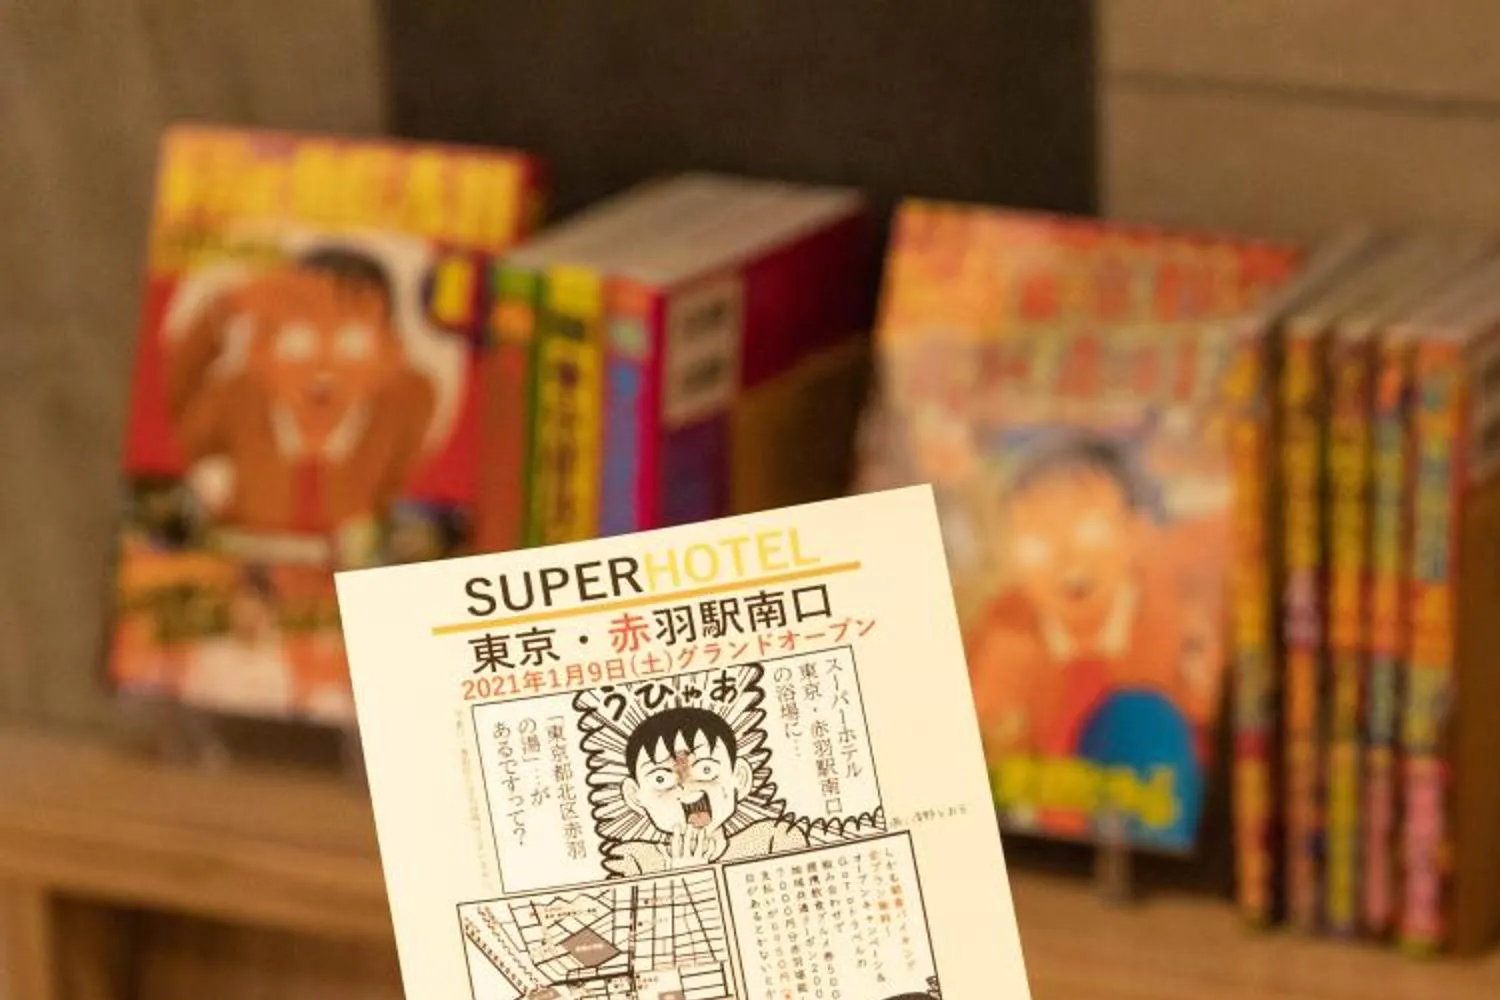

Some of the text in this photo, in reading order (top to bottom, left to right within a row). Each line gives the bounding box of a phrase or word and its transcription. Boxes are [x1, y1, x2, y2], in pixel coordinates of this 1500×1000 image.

[461, 618, 877, 700] 2021年1月9日(土)グランドオープン
[469, 583, 832, 675] 東京・赤羽駅南口
[602, 670, 737, 721] うひゃあ
[799, 662, 843, 814] 東京・赤羽駅南口
[826, 657, 862, 779] スーパーホテル
